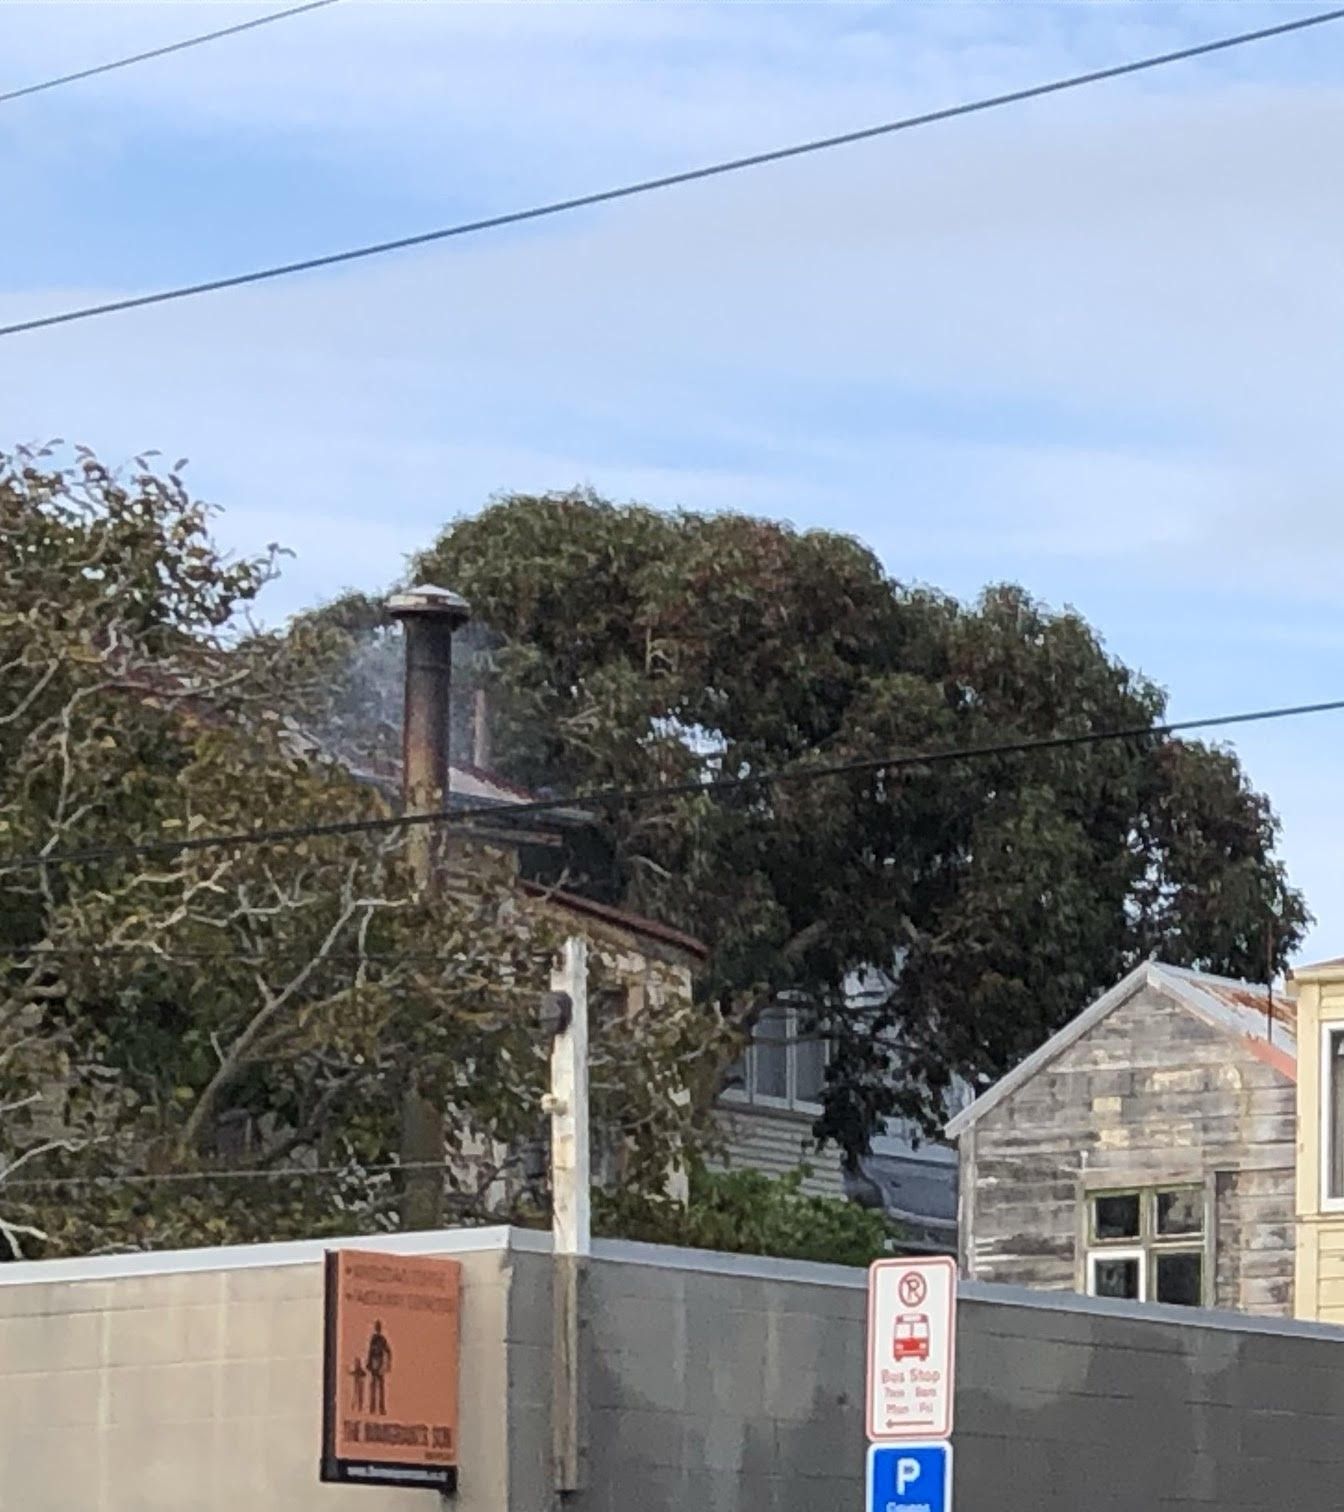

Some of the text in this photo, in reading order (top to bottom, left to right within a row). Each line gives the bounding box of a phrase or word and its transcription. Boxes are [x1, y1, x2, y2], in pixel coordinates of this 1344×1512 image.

[881, 1368, 940, 1385] Bus Stop
[896, 1457, 921, 1496] P
